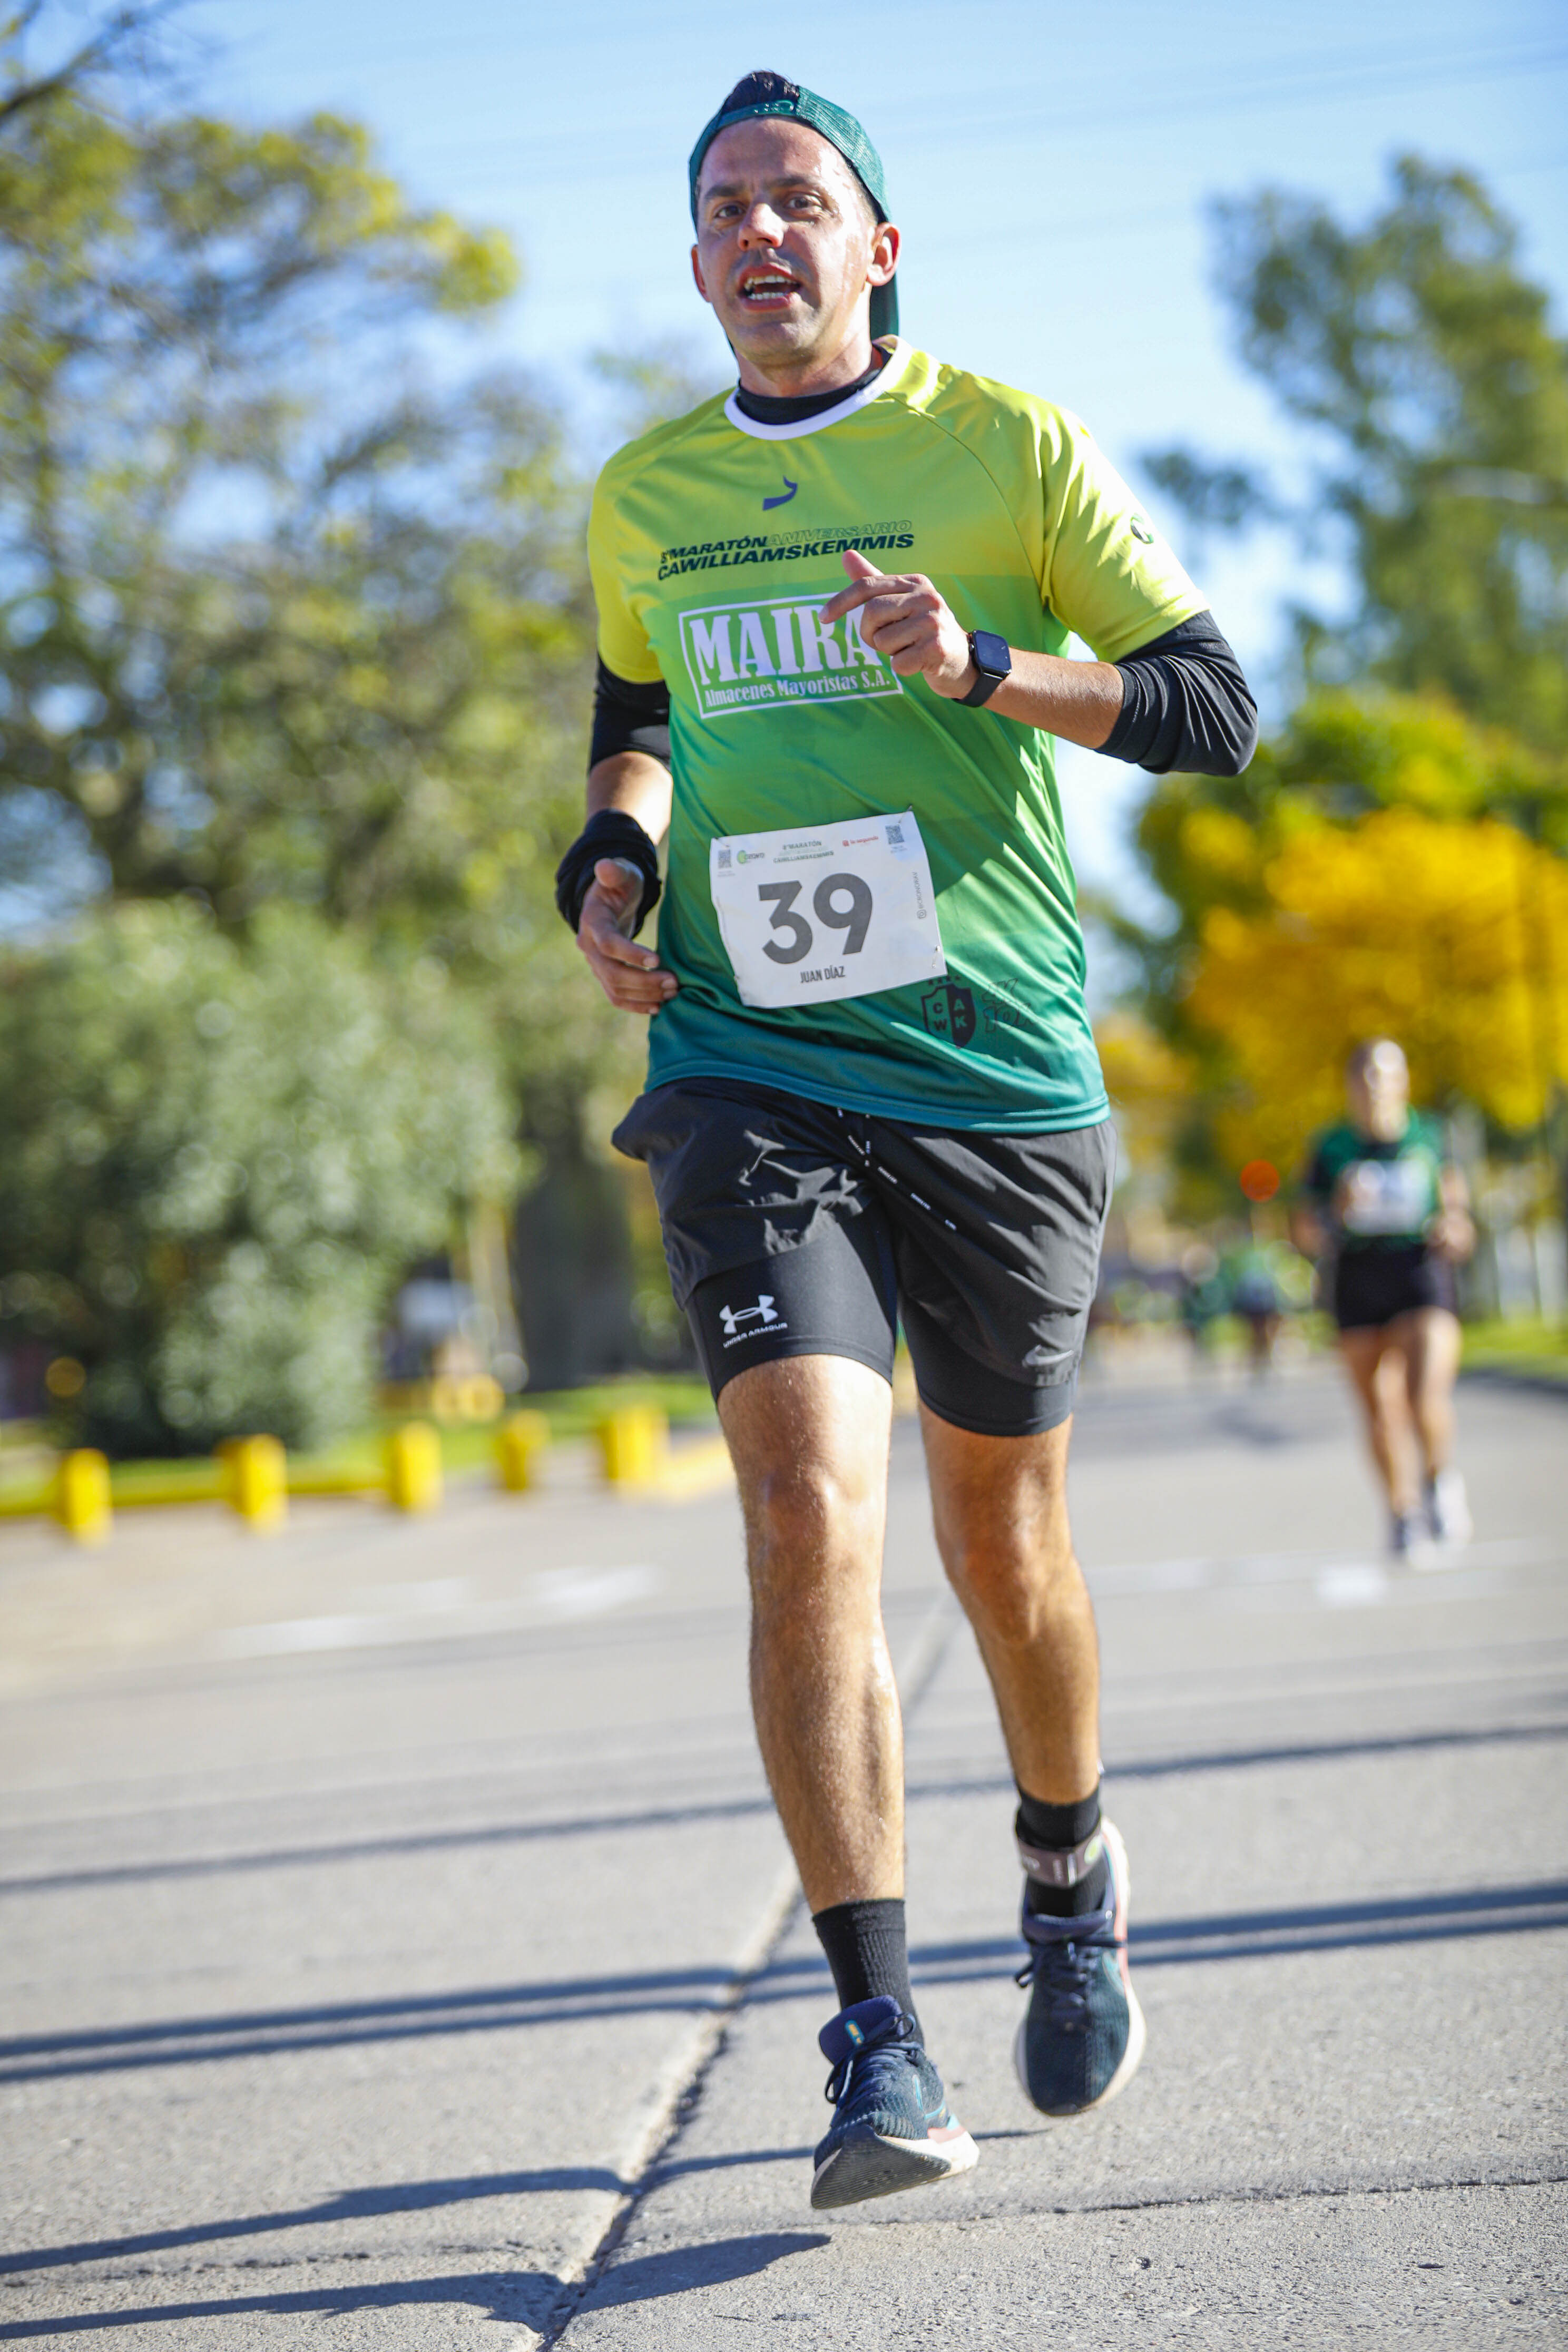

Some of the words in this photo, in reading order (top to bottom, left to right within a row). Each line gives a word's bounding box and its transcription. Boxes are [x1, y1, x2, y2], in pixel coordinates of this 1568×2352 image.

[768, 520, 912, 546] ANIVERSARIO
[689, 605, 882, 685] MAIRA
[705, 682, 775, 708] Almacenes
[776, 673, 858, 696] Mayoristas
[862, 670, 890, 689] S.A.
[758, 873, 873, 964] 39
[800, 968, 822, 983] JUAN
[824, 965, 846, 980] DÍAZ
[933, 1003, 943, 1014] C
[954, 998, 965, 1011] A
[934, 1020, 947, 1031] W
[955, 1015, 967, 1028] K
